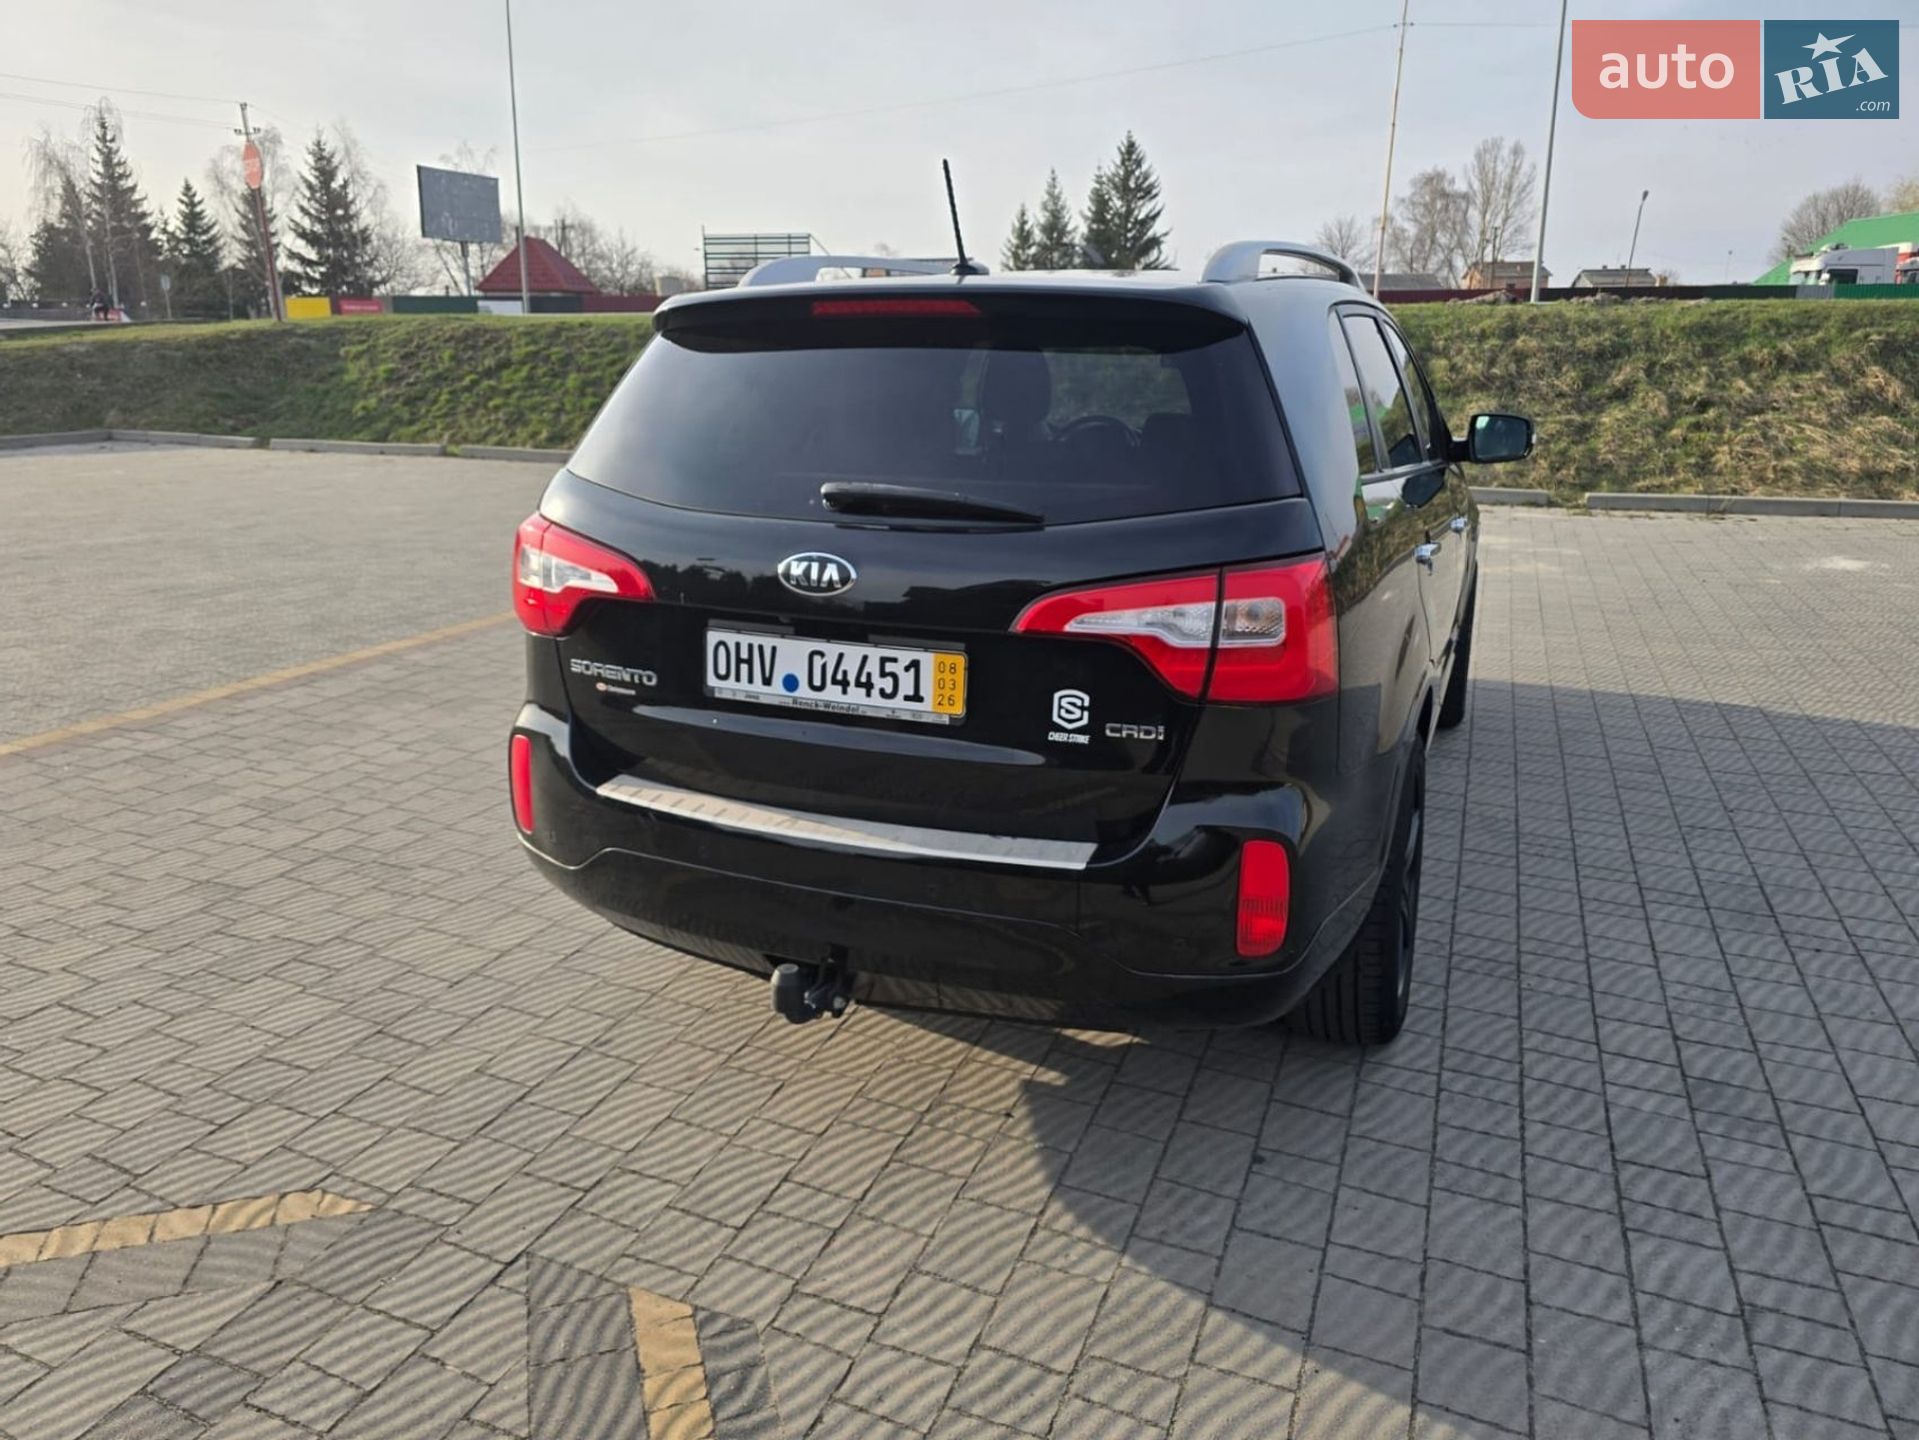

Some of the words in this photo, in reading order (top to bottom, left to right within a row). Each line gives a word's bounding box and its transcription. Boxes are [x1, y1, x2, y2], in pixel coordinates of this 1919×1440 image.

[789, 560, 842, 588] KIA
[569, 658, 659, 687] SORENTO
[712, 639, 777, 687] OHV
[807, 649, 924, 704] 04451
[937, 661, 957, 675] 08
[937, 677, 956, 691] 03
[936, 694, 955, 707] 26
